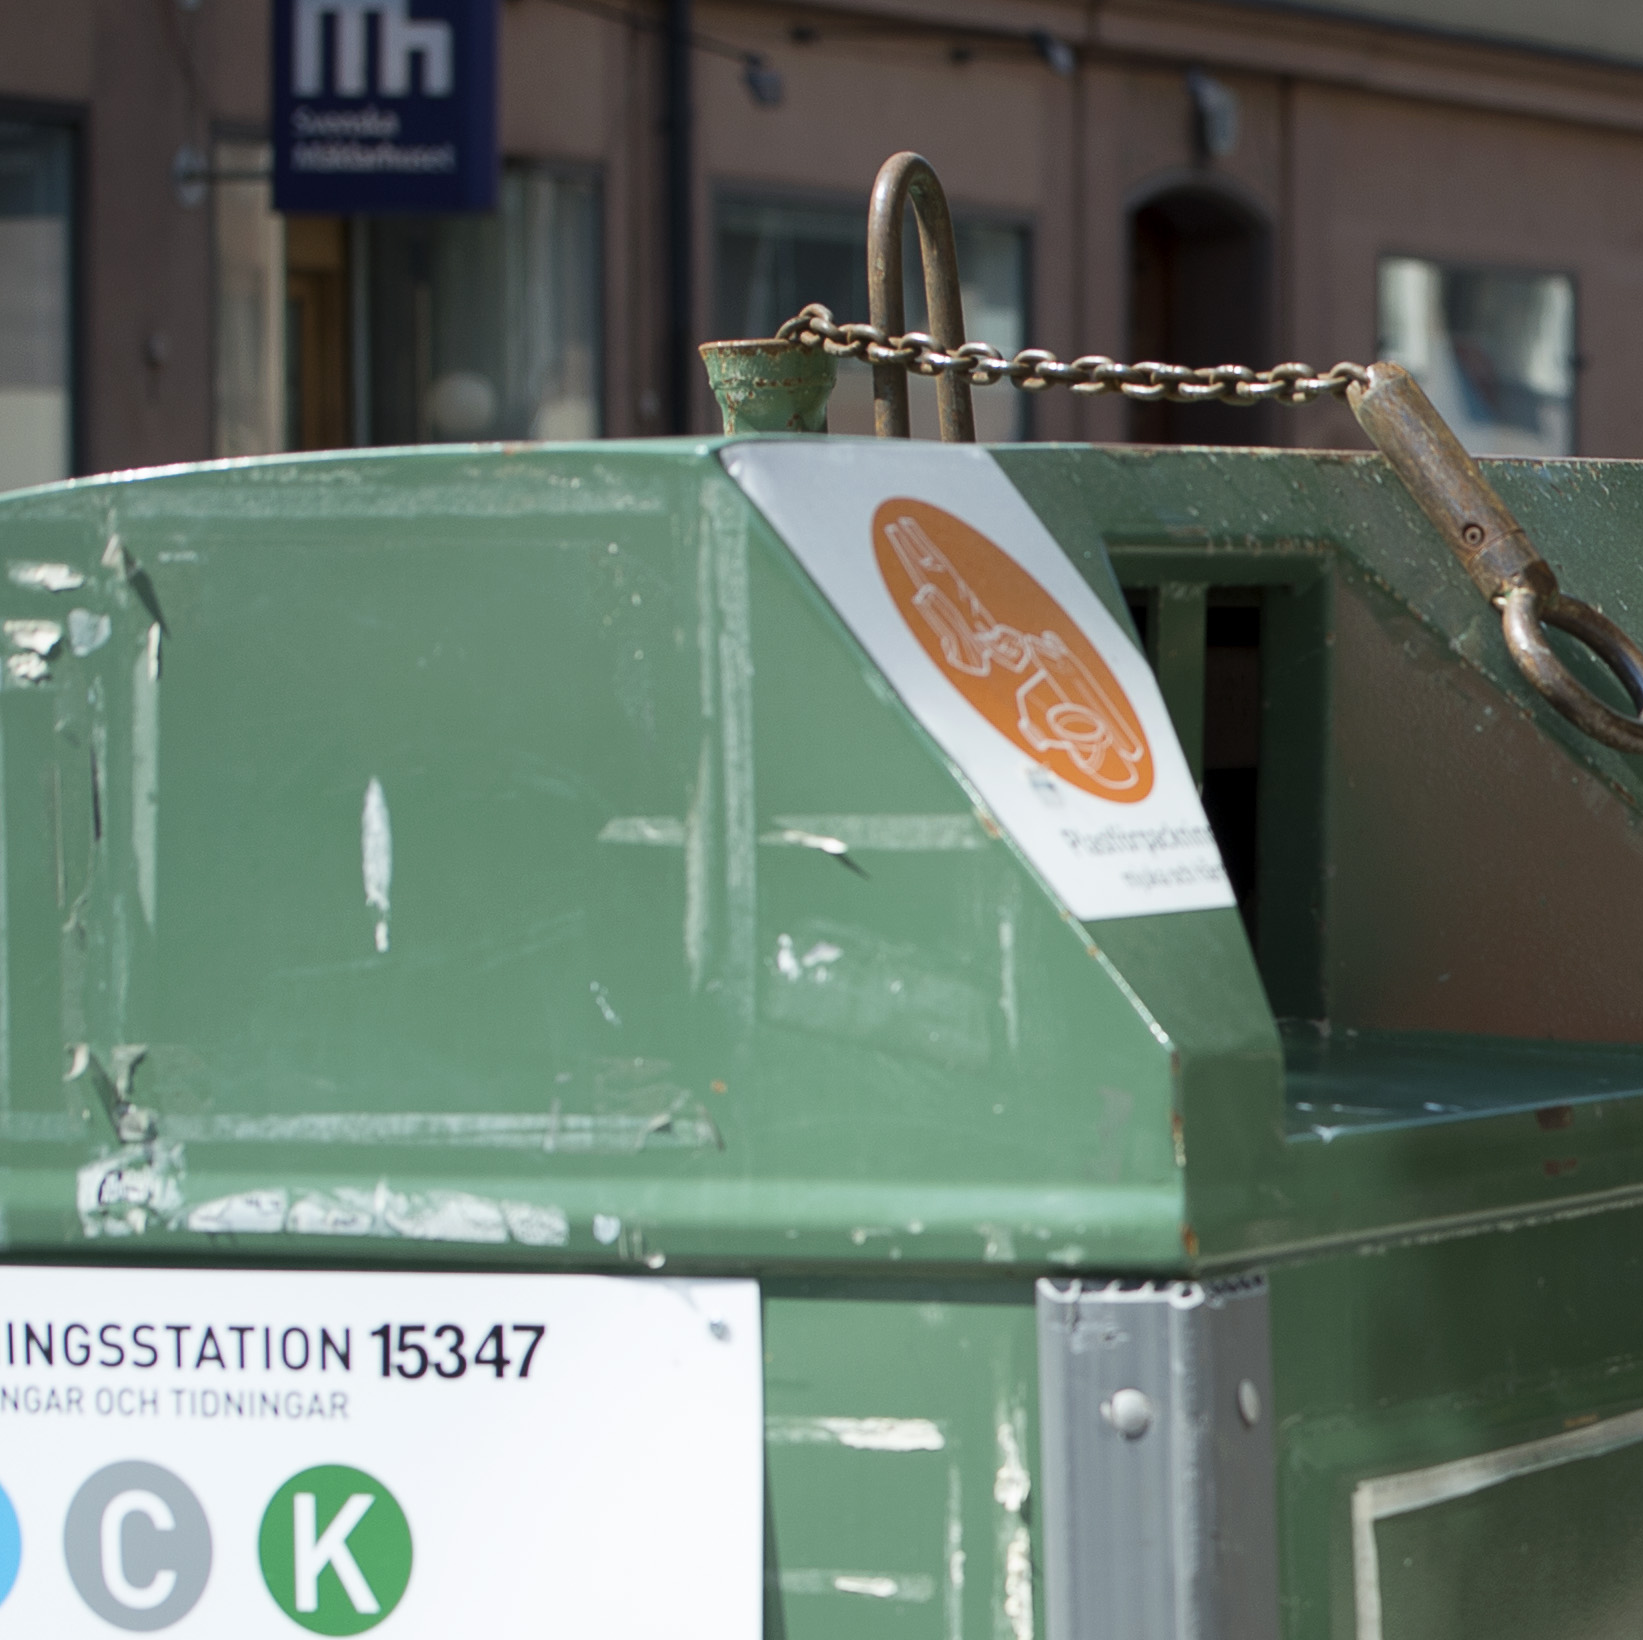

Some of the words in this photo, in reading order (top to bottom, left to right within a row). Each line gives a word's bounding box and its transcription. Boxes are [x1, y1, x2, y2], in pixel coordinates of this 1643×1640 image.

[5, 1322, 352, 1371] INGSSTATION
[371, 1323, 547, 1379] 15347
[0, 1385, 85, 1416] NGAR
[95, 1386, 158, 1417] OCH
[174, 1387, 350, 1420] TIDNINGAR
[98, 1489, 179, 1611] C
[291, 1491, 382, 1616] K
